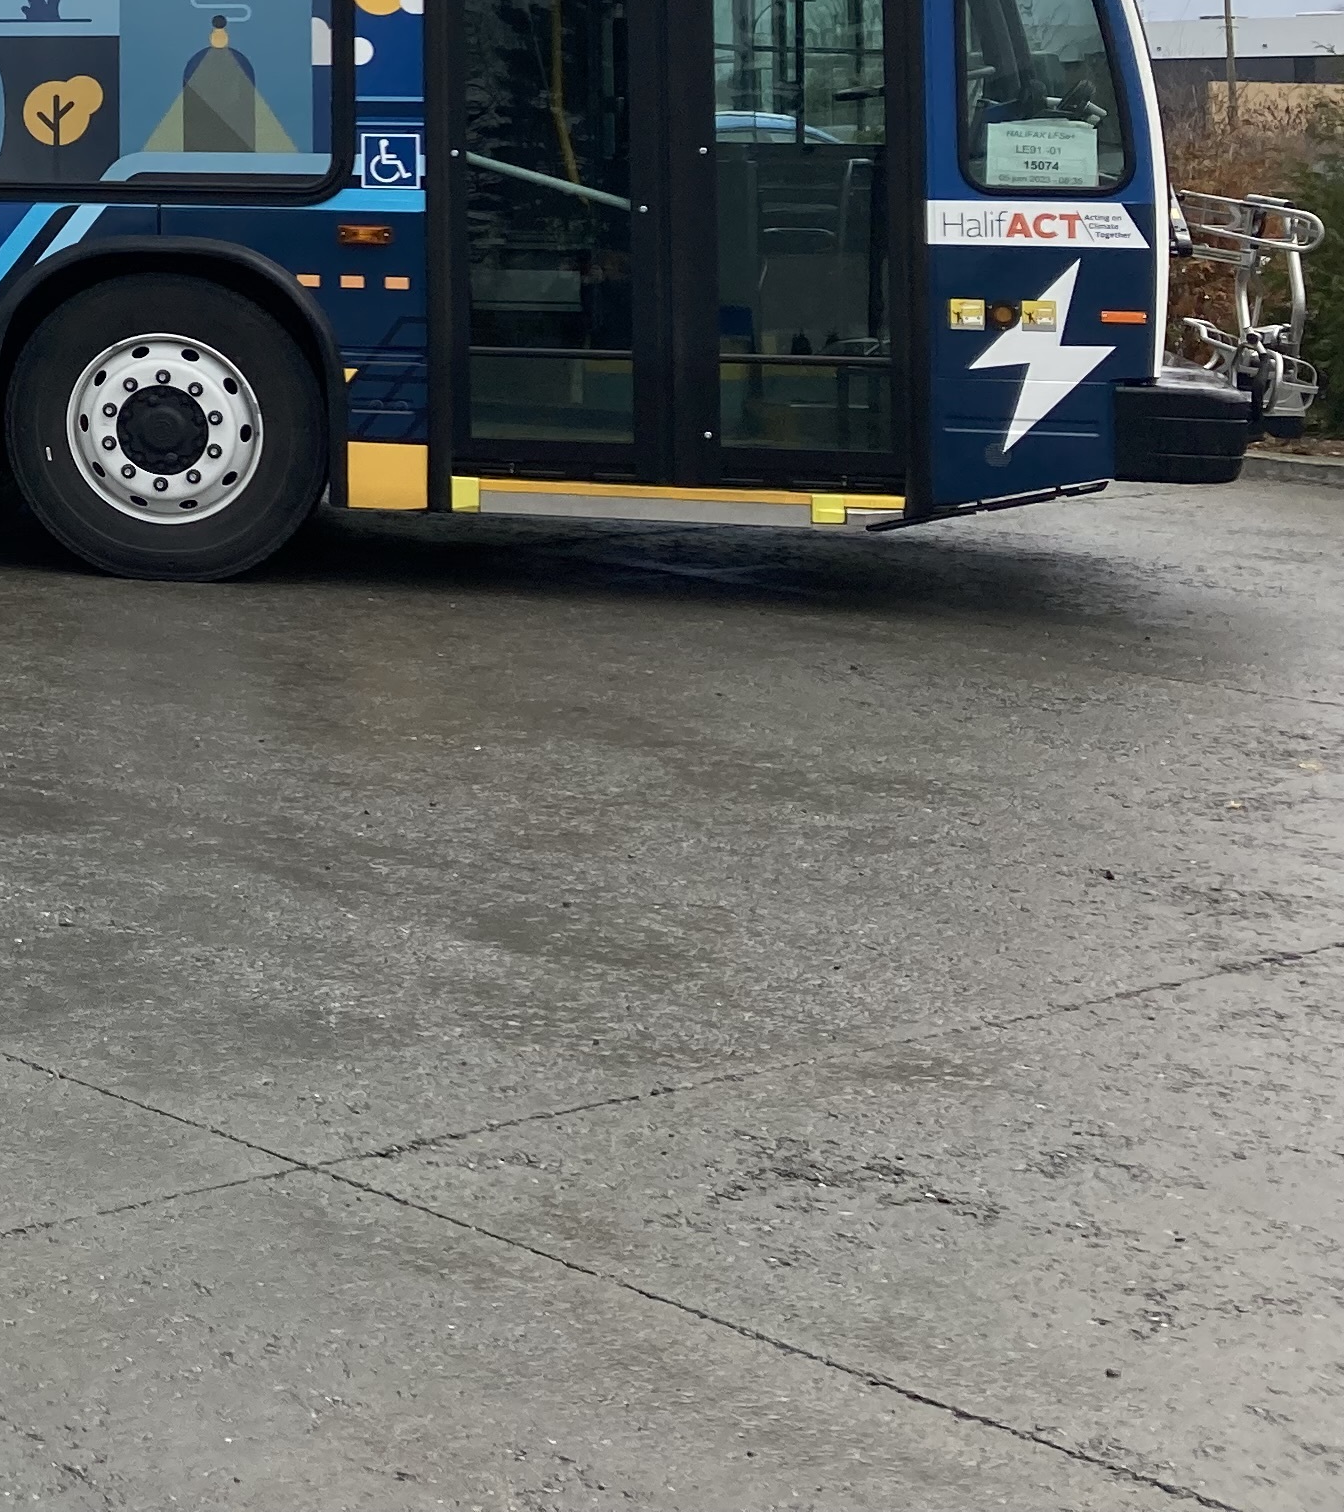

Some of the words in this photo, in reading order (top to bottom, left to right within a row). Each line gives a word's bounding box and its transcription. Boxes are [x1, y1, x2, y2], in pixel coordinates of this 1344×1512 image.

[1006, 130, 1046, 139] HALIFAX
[1015, 144, 1042, 155] LE91
[1023, 160, 1059, 171] 15074
[1084, 214, 1110, 223] Acting
[942, 210, 1081, 239] HalifACT
[1088, 222, 1119, 230] Climate
[1095, 231, 1132, 240] Together
